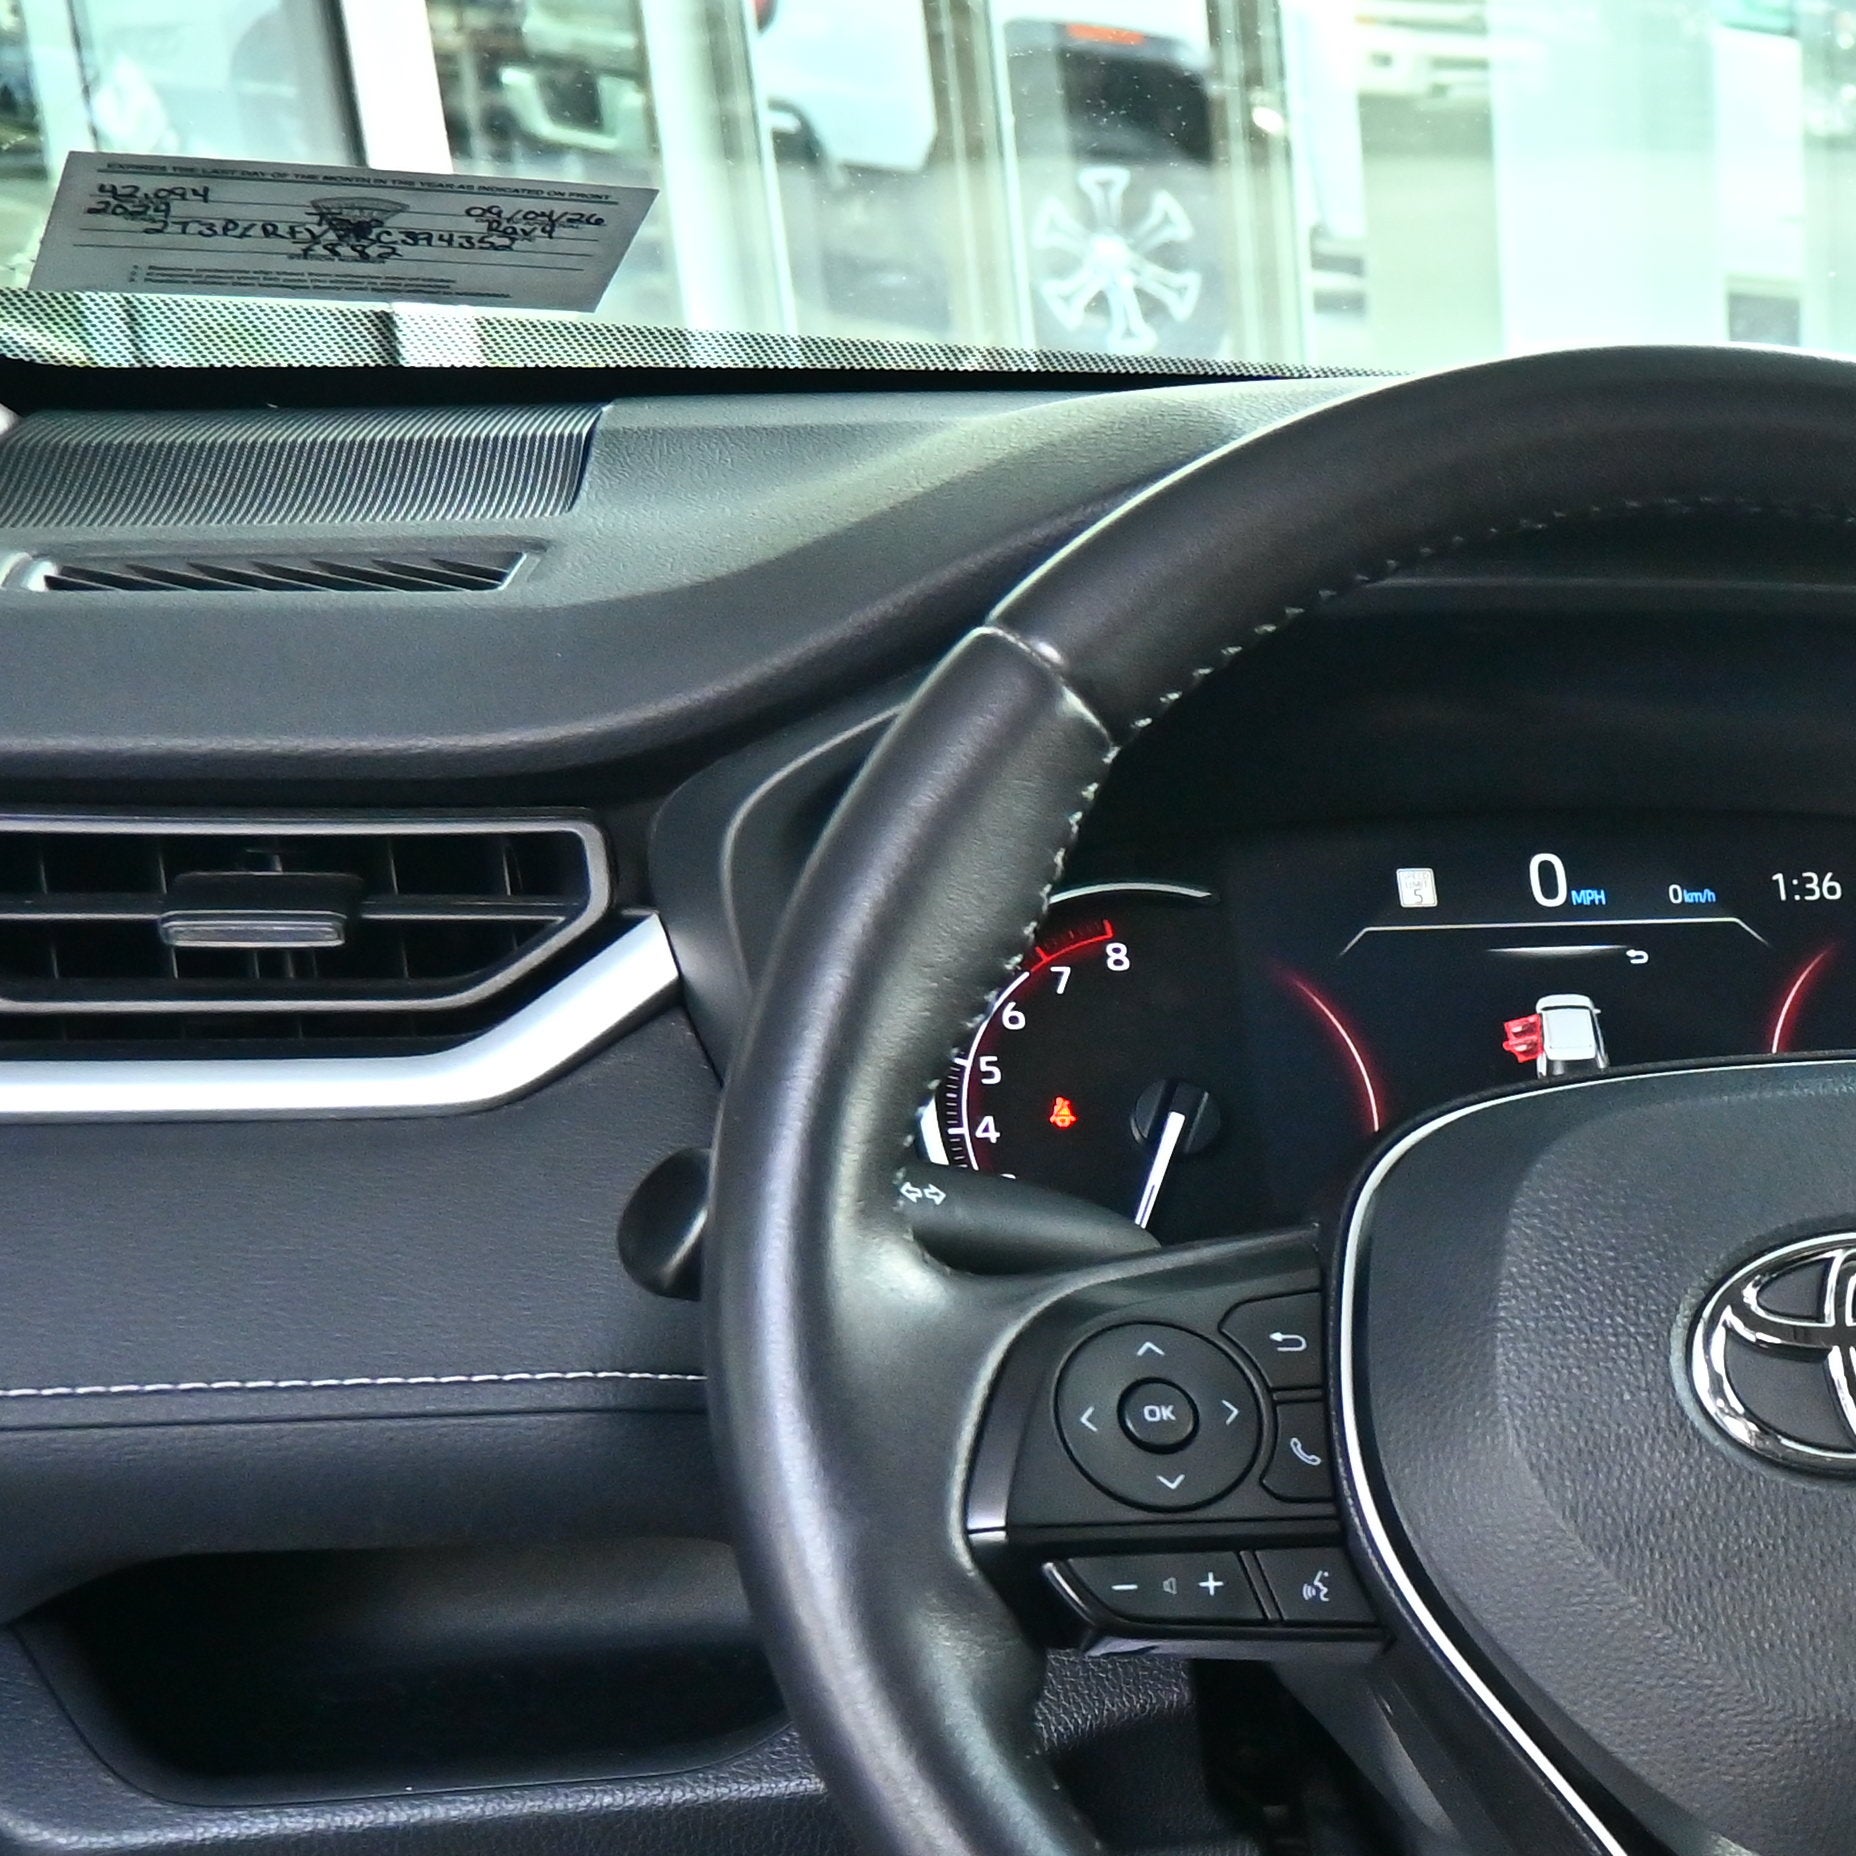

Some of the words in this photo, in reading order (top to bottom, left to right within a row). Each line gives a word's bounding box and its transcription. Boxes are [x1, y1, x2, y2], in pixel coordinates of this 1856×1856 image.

[1528, 852, 1568, 908] 0
[1571, 889, 1606, 906] MPH
[1667, 884, 1683, 904] 0
[1684, 887, 1717, 905] km/h
[1771, 871, 1843, 902] 1:36
[1105, 942, 1131, 972] 8
[1049, 965, 1072, 995] 7
[1001, 1001, 1027, 1031] 6
[978, 1055, 1002, 1085] 5
[974, 1115, 1001, 1144] 4
[1143, 1404, 1177, 1422] OK
